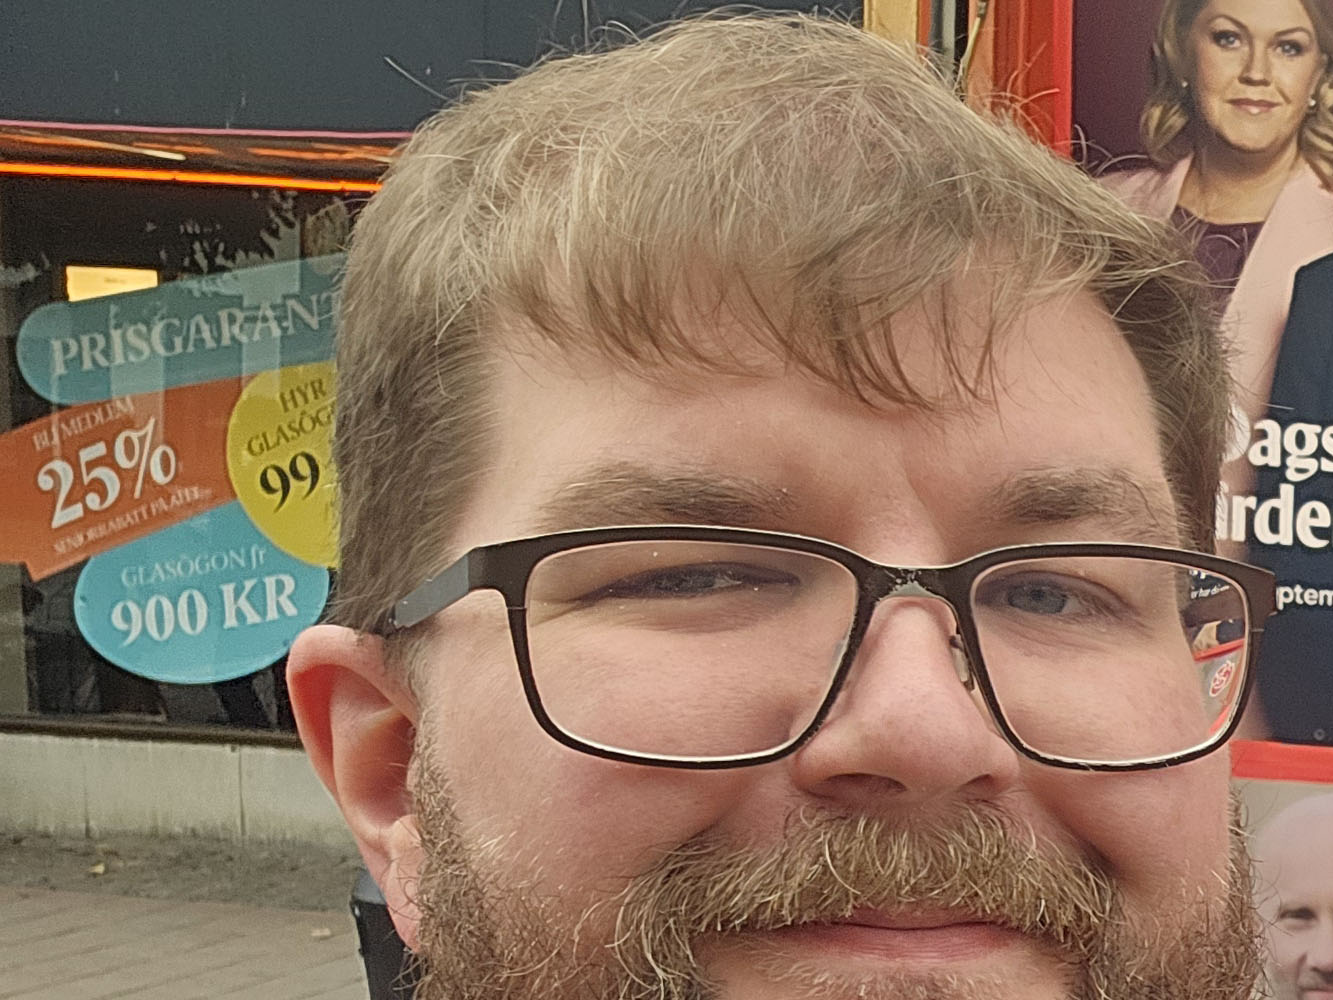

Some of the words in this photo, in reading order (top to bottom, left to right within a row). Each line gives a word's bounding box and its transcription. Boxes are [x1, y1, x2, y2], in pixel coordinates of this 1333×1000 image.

[51, 292, 338, 377] PRISGARANT
[280, 378, 327, 413] HYR
[247, 401, 336, 457] GLASÖG
[37, 416, 176, 529] 25%
[121, 549, 246, 587] GLASÖGON
[111, 588, 209, 649] 900
[219, 573, 298, 629] KR
